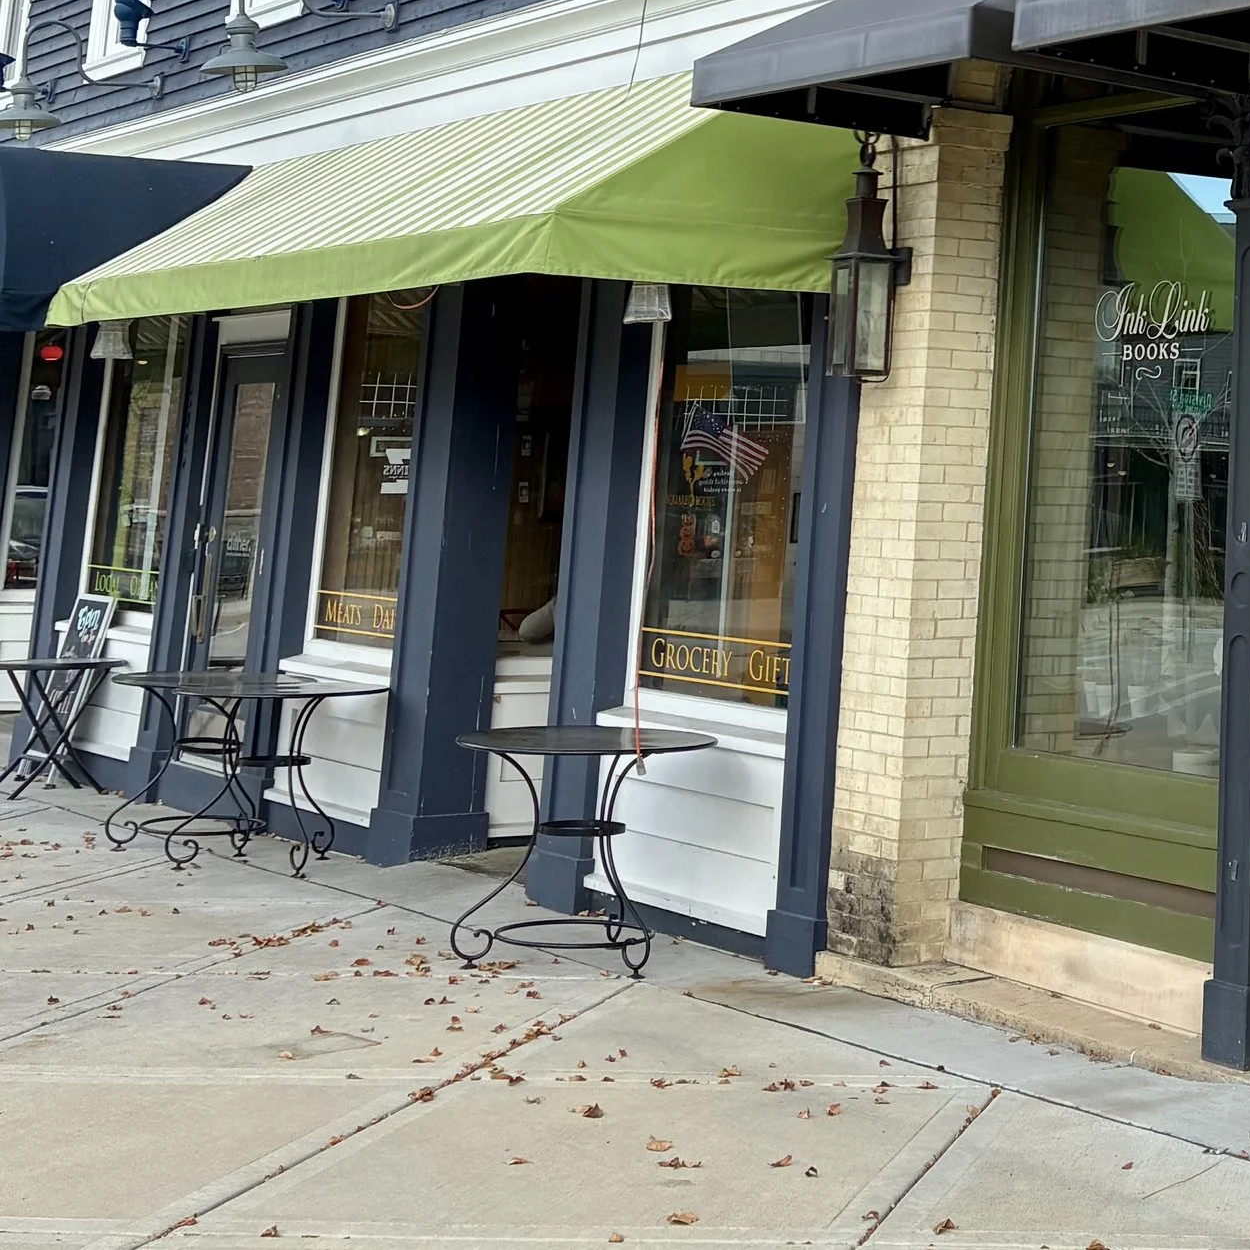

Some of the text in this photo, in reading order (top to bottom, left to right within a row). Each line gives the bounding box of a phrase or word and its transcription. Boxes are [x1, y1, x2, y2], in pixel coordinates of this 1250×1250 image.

[1095, 280, 1210, 342] Ink Link
[1122, 342, 1180, 361] BOOKS
[325, 599, 362, 626] MEATS
[651, 637, 791, 685] GROCERY GIFT
